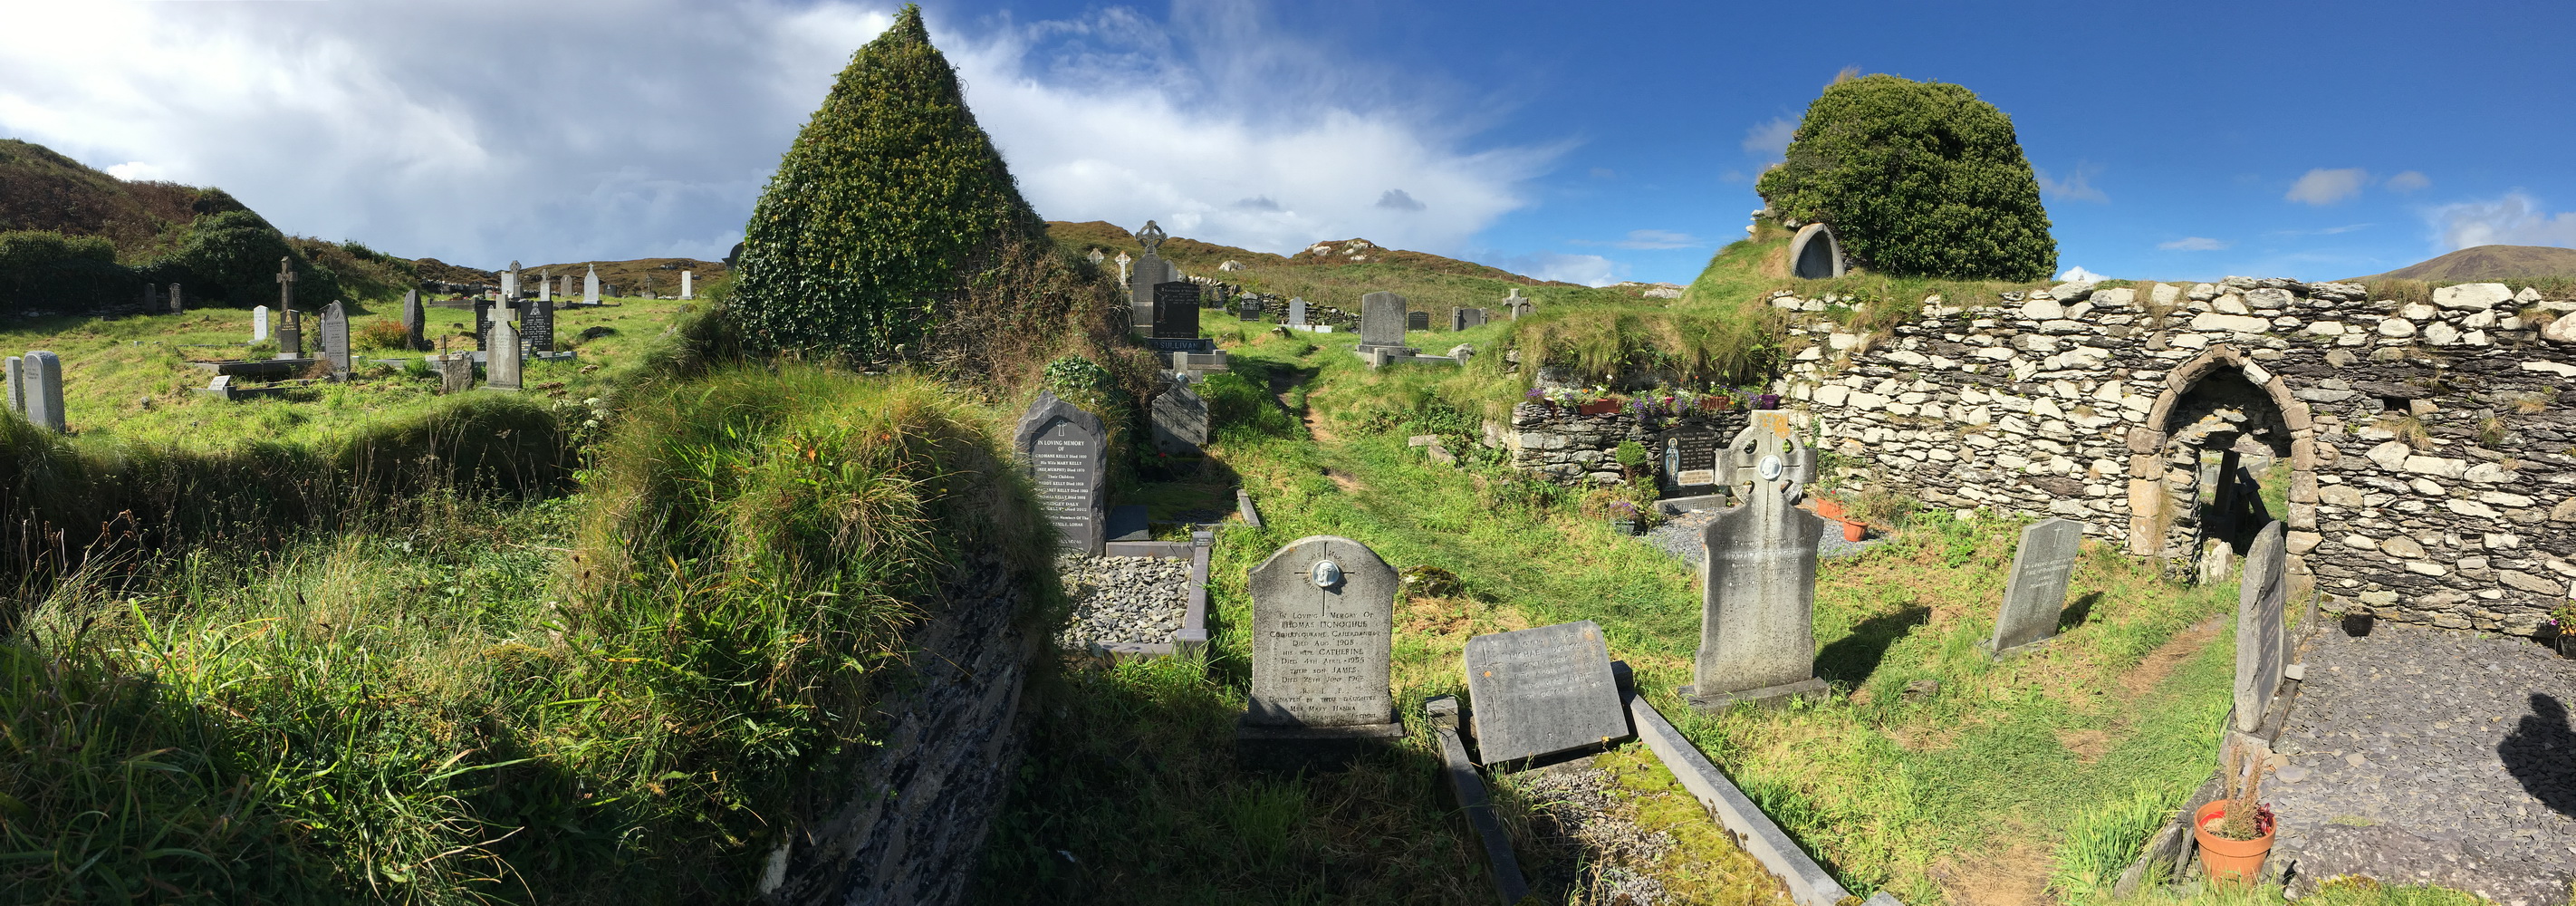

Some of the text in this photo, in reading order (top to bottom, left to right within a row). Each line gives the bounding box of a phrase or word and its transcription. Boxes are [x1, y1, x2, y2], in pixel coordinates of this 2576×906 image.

[1509, 640, 1596, 660] MICHAEL DONOGHUE
[1518, 639, 1544, 648] LOVING
